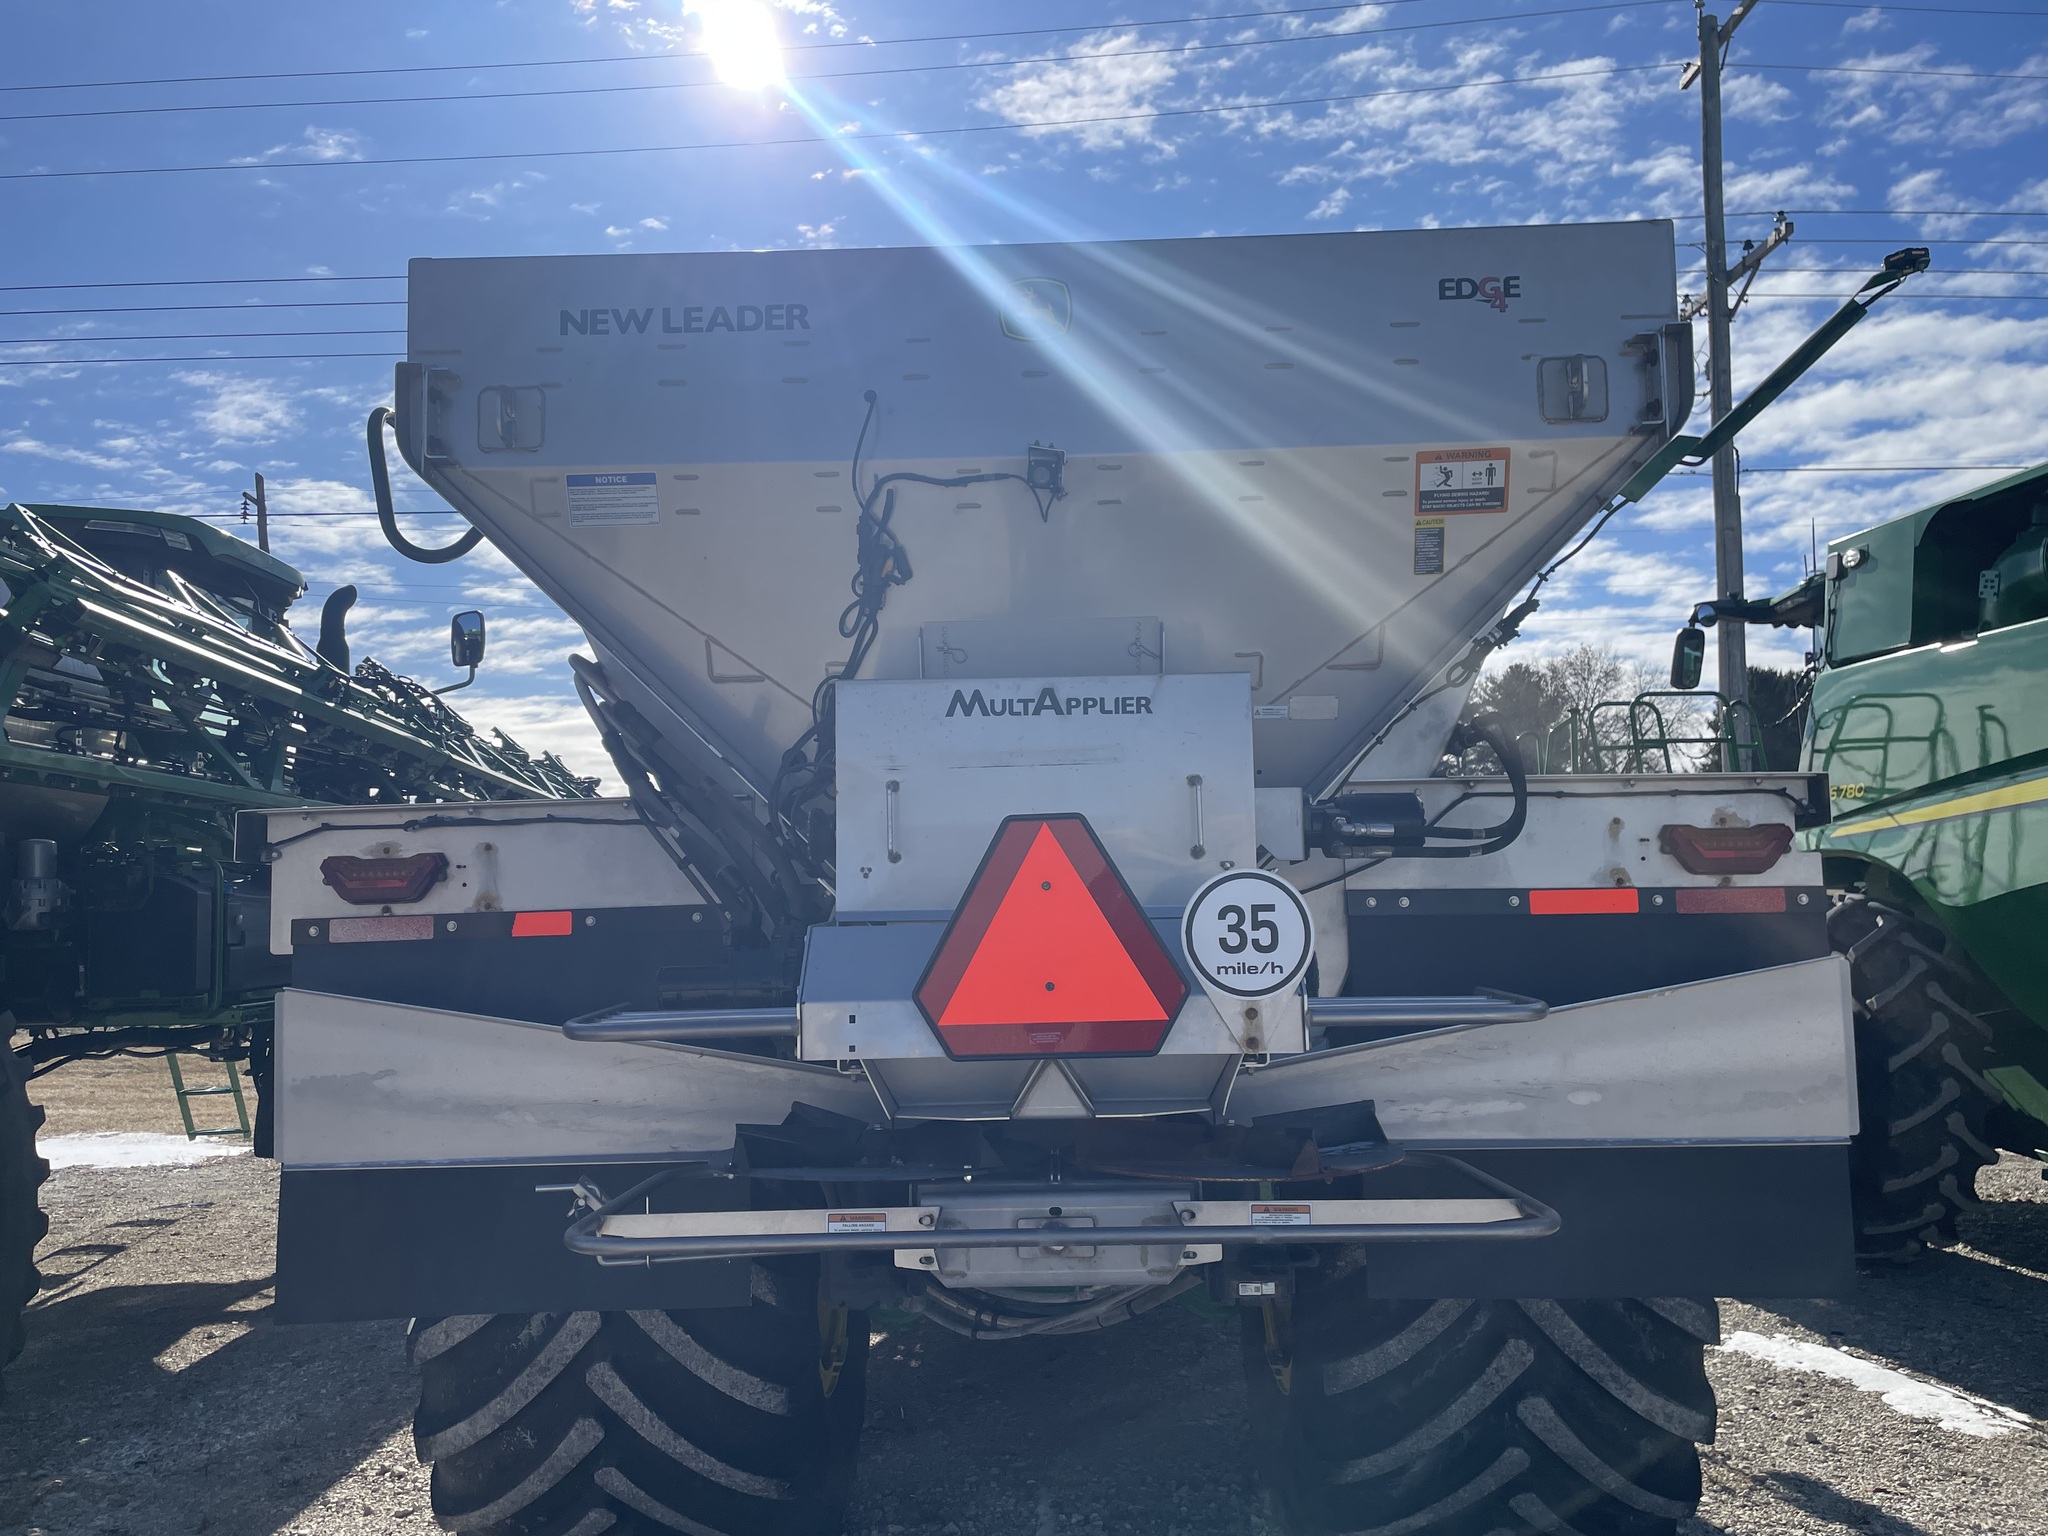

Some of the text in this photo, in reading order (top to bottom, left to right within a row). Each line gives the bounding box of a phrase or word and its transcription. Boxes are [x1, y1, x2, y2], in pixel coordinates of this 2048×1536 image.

[1439, 276, 1521, 300] EDGE
[560, 304, 811, 336] NEW LEADER
[1446, 451, 1492, 460] WARNING
[595, 475, 628, 484] NOTICE
[1217, 904, 1279, 954] 35
[1216, 962, 1284, 975] mile/h
